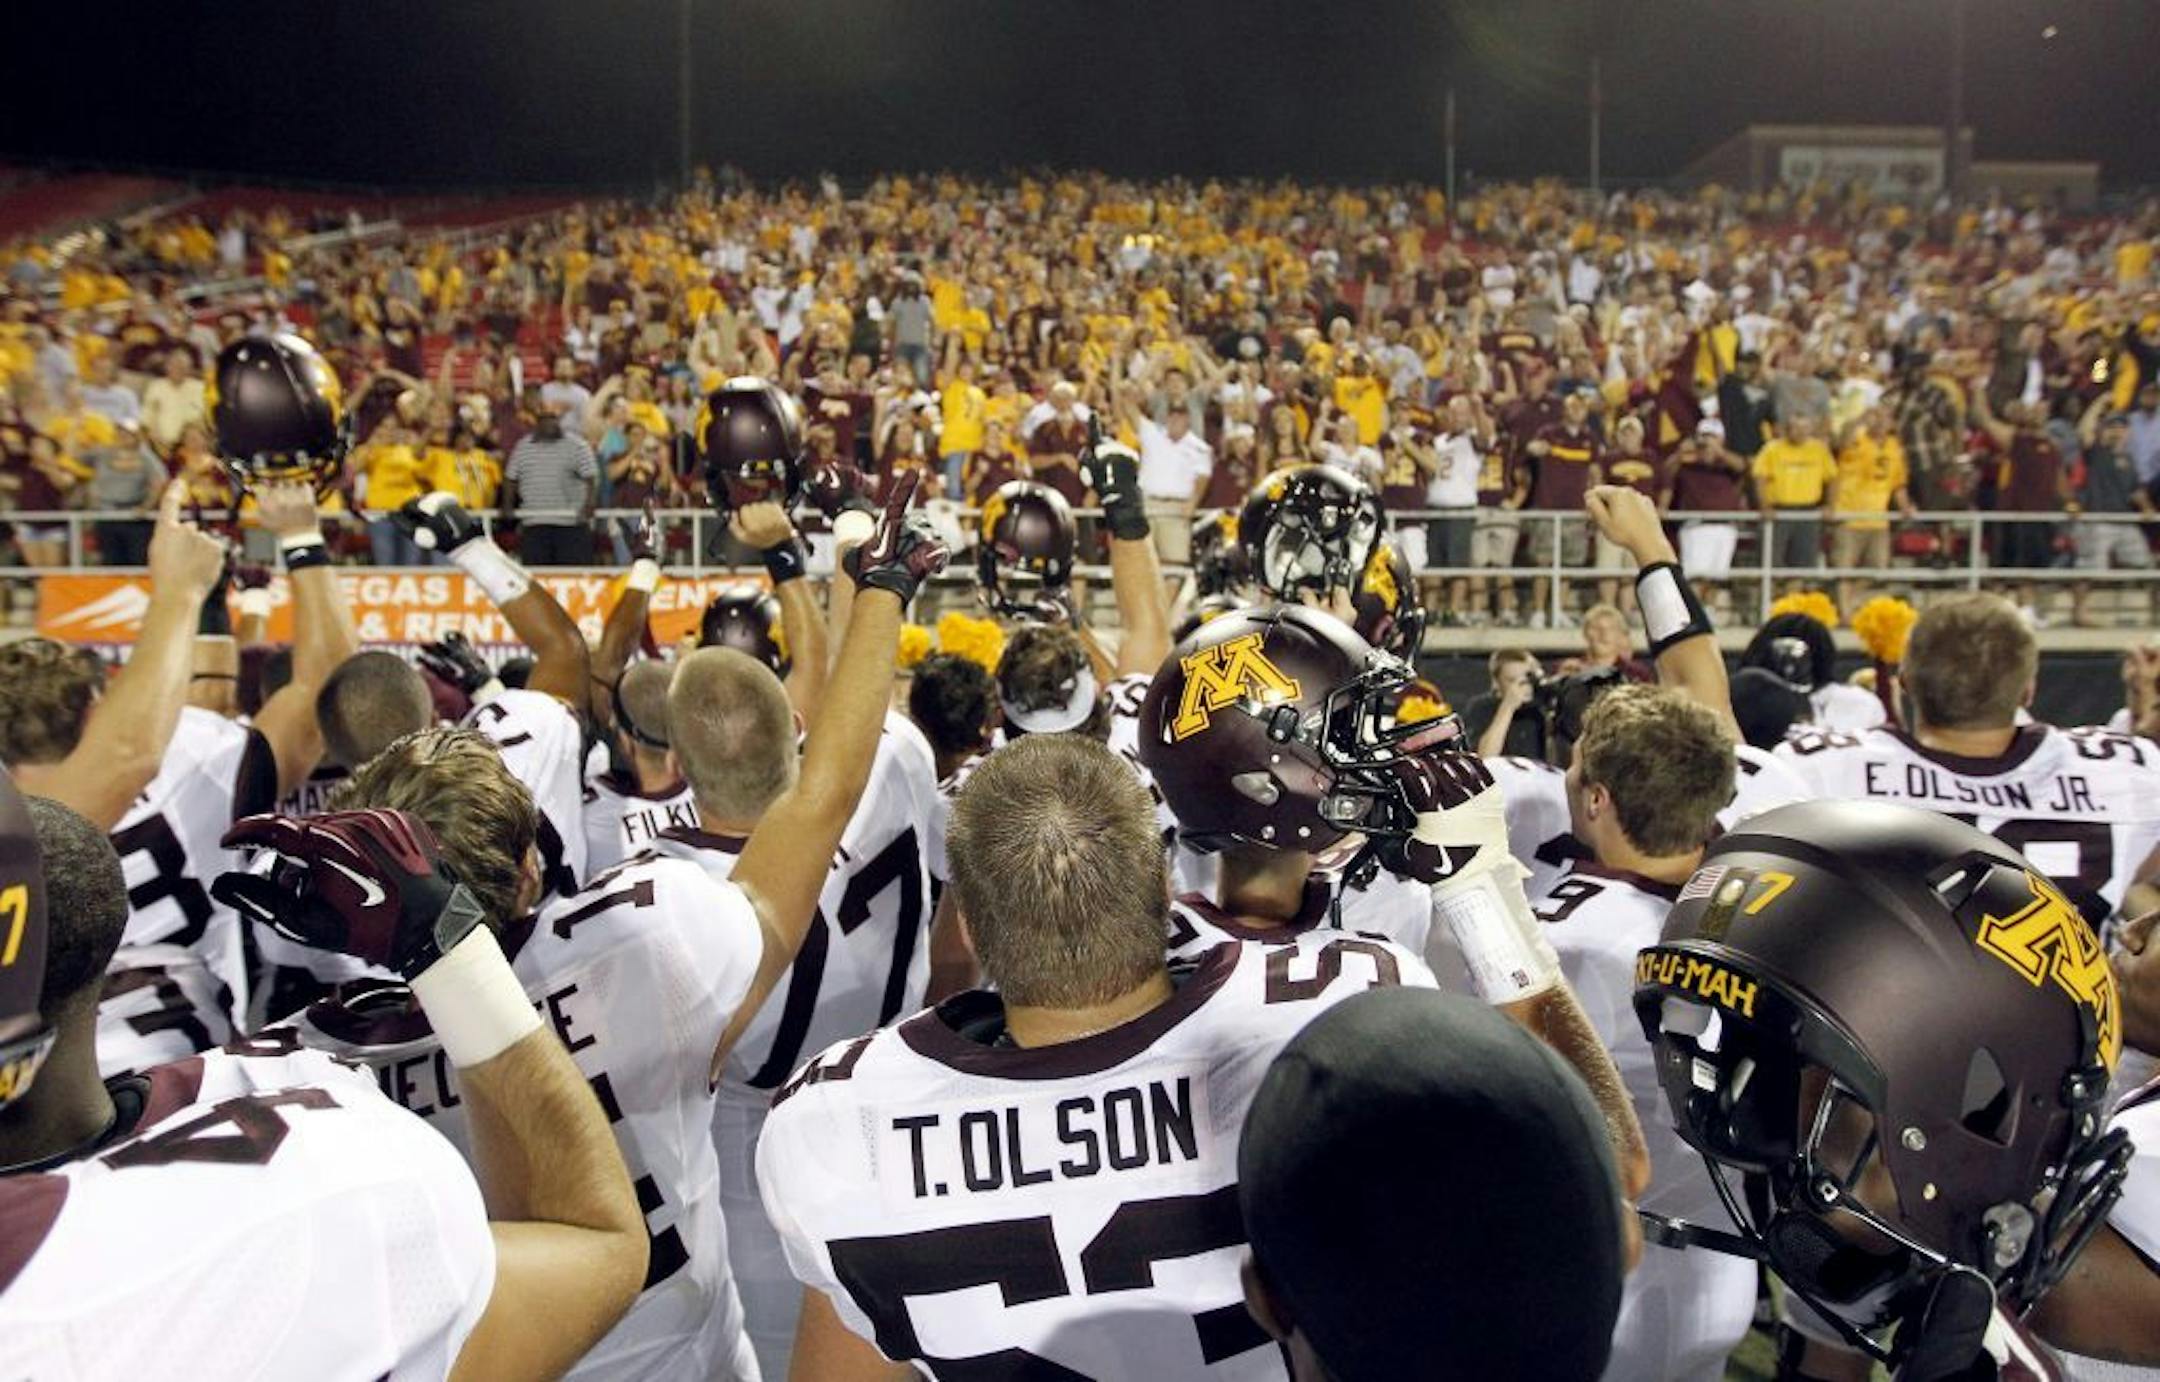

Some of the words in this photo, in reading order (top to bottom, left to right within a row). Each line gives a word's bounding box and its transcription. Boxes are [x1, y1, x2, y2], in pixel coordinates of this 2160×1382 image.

[337, 575, 448, 606] EGAS
[1173, 632, 1302, 742] M
[1743, 872, 1796, 915] 7
[892, 1076, 1200, 1199] T.OLSON
